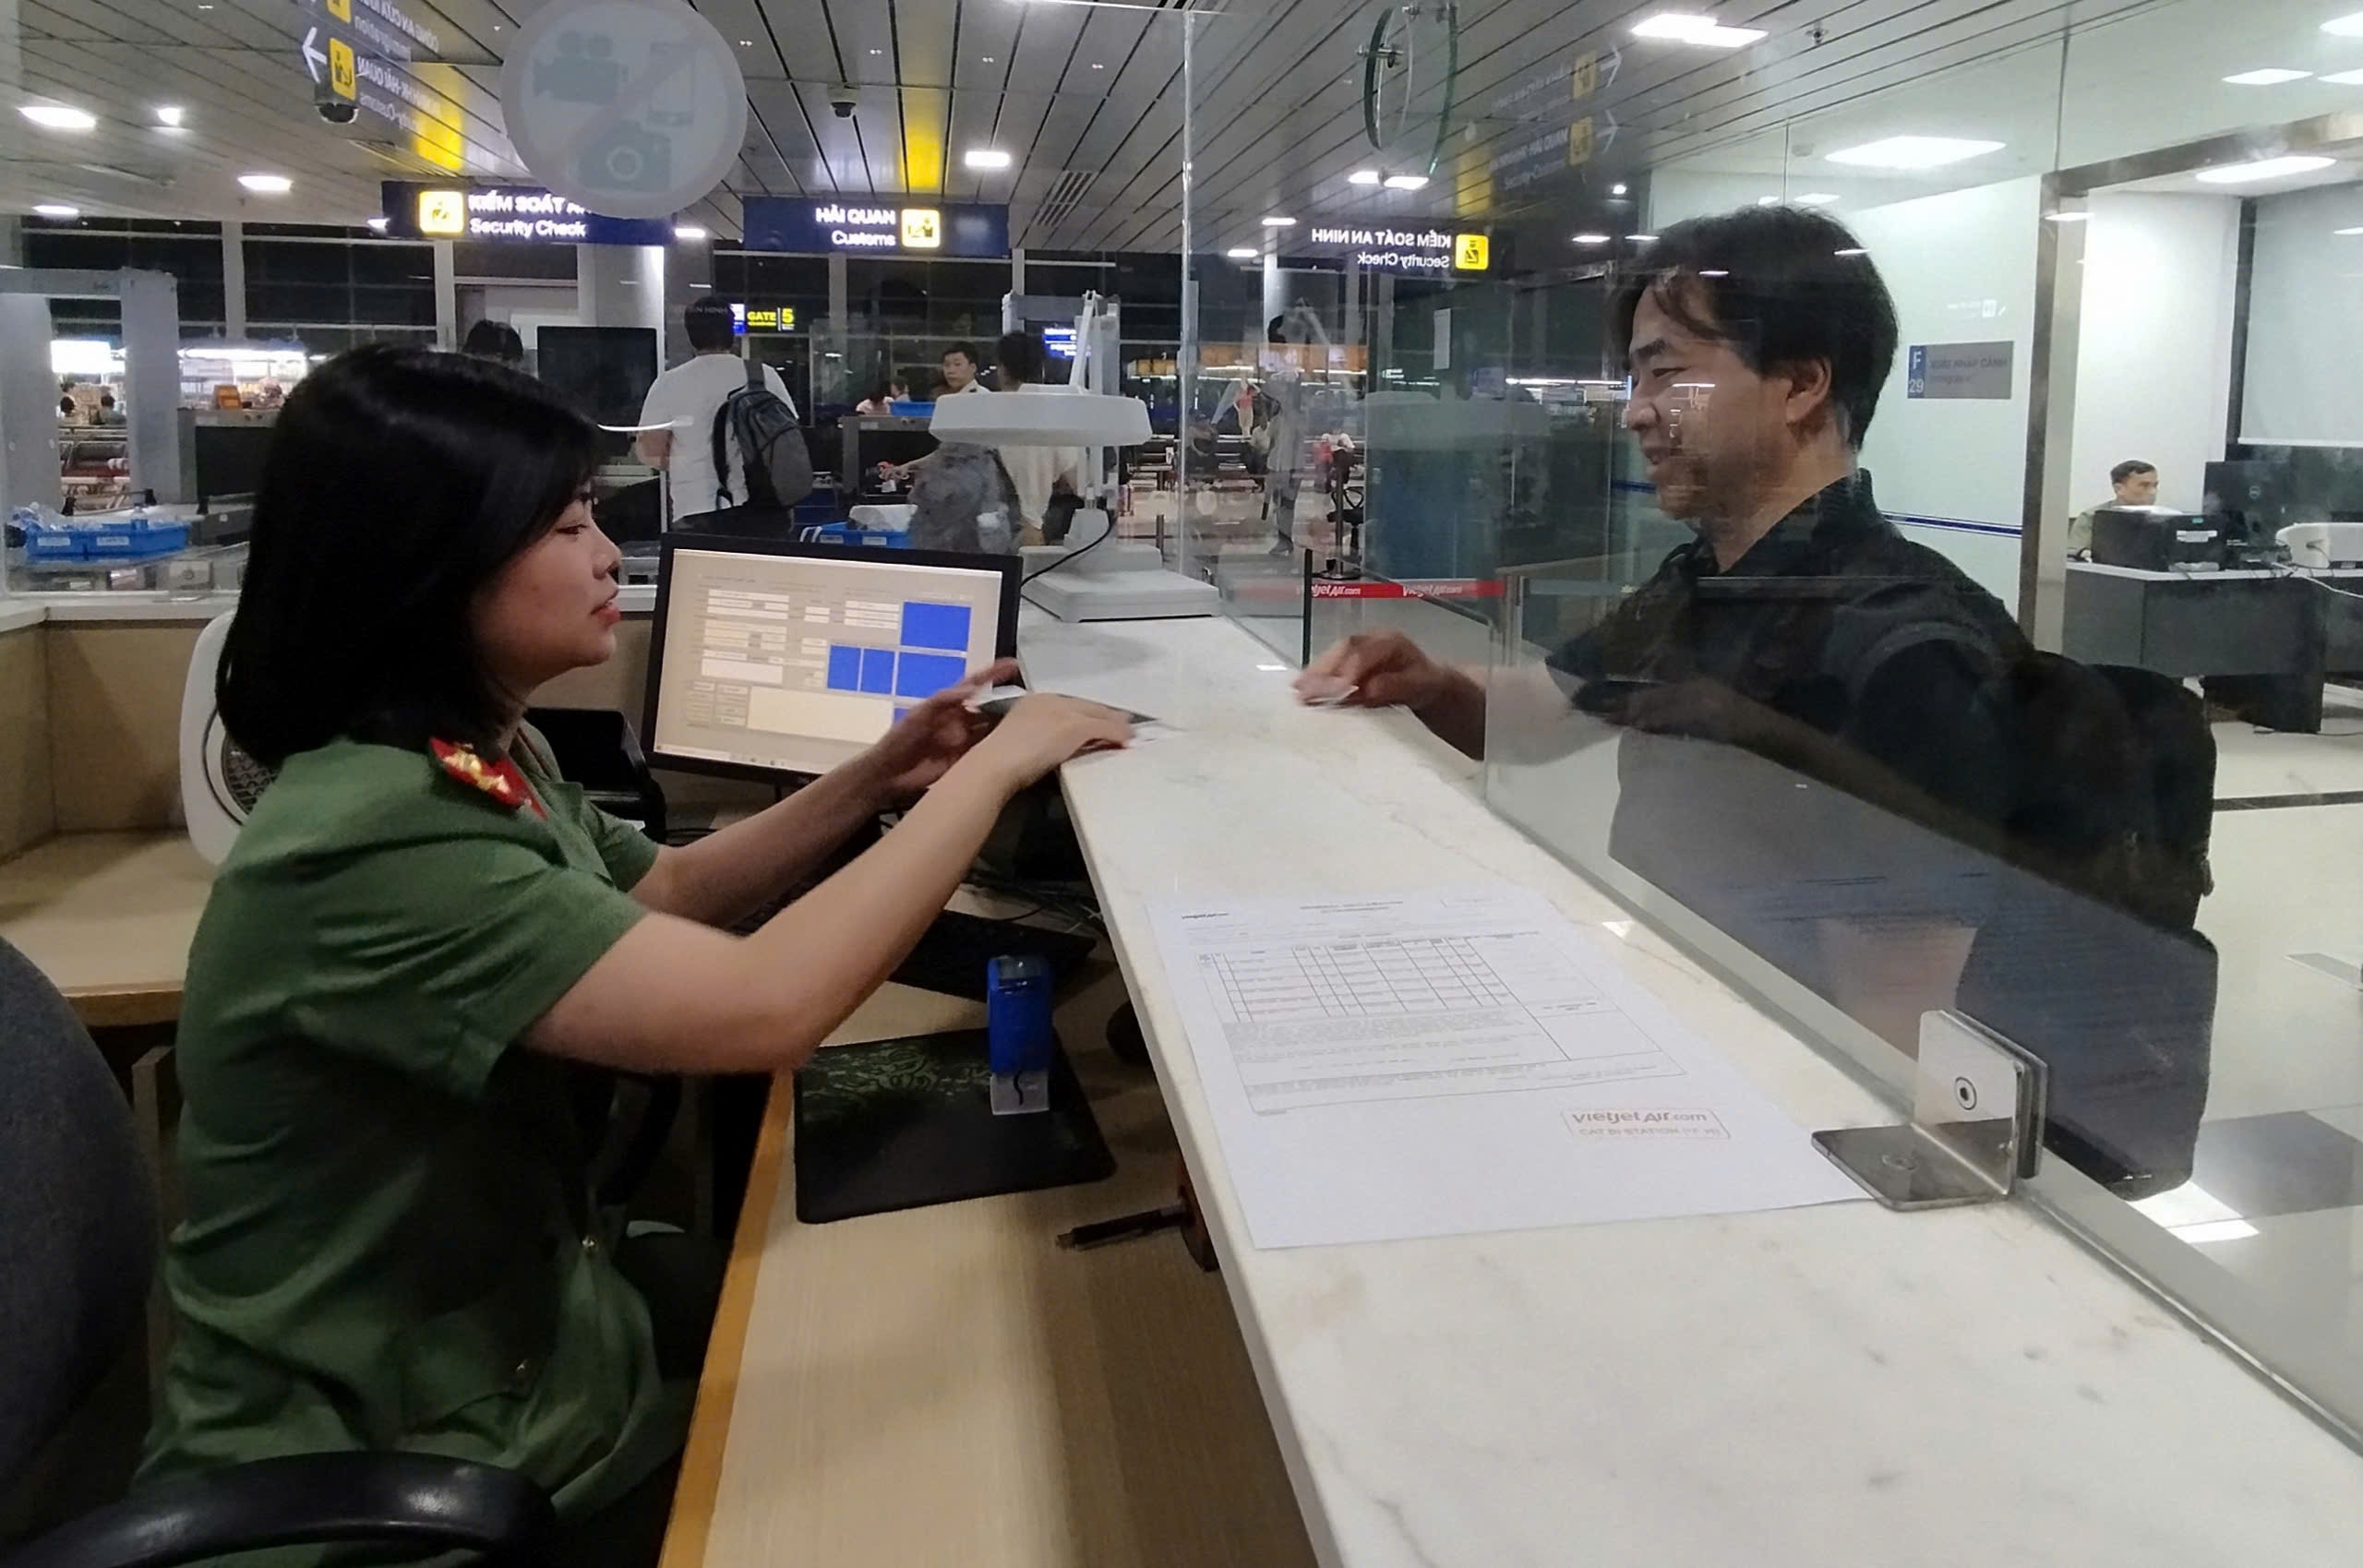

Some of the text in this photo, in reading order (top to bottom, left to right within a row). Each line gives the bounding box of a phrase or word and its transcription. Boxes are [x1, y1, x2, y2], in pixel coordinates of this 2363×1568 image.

[847, 208, 896, 224] QUAN
[470, 219, 586, 238] Security Check
[832, 230, 896, 246] Customs
[747, 311, 776, 322] GATE
[781, 307, 794, 324] 5
[1912, 351, 1922, 369] F
[1908, 377, 1924, 393] 29
